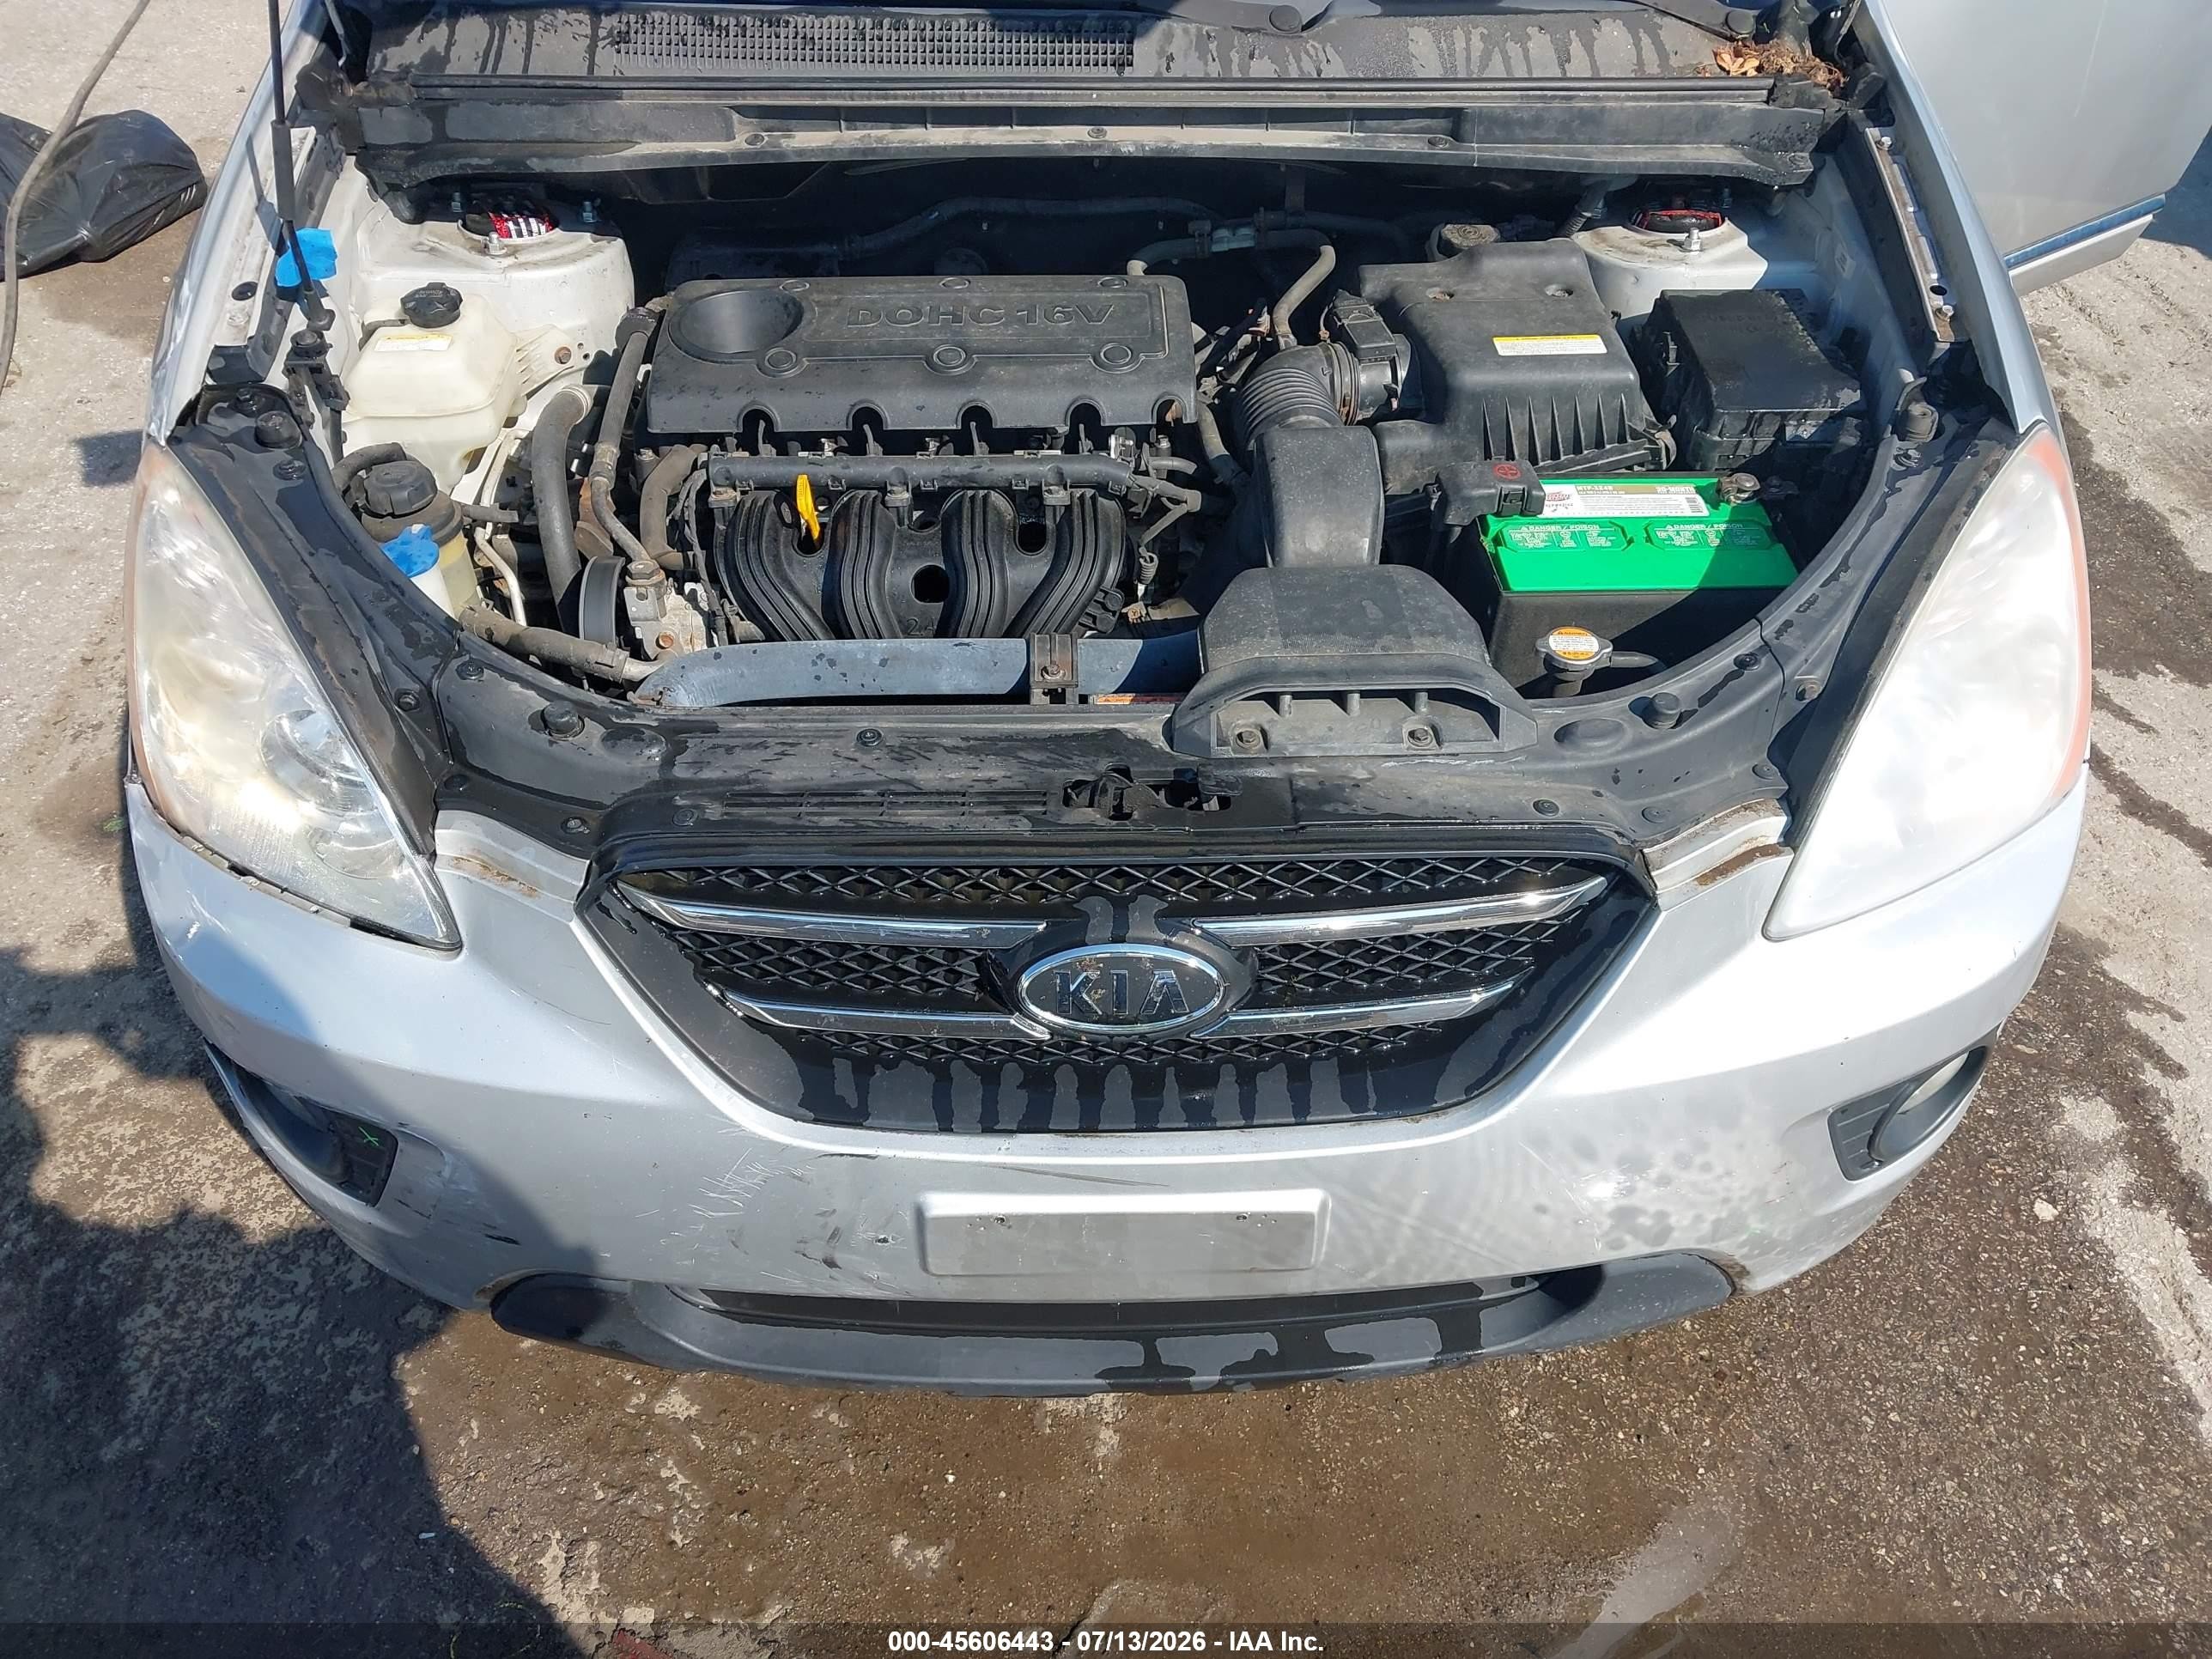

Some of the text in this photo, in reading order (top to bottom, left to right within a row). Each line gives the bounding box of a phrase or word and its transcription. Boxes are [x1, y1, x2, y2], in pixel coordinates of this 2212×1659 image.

[847, 303, 1115, 327] DOHC 16V
[1054, 969, 1189, 1015] KIA
